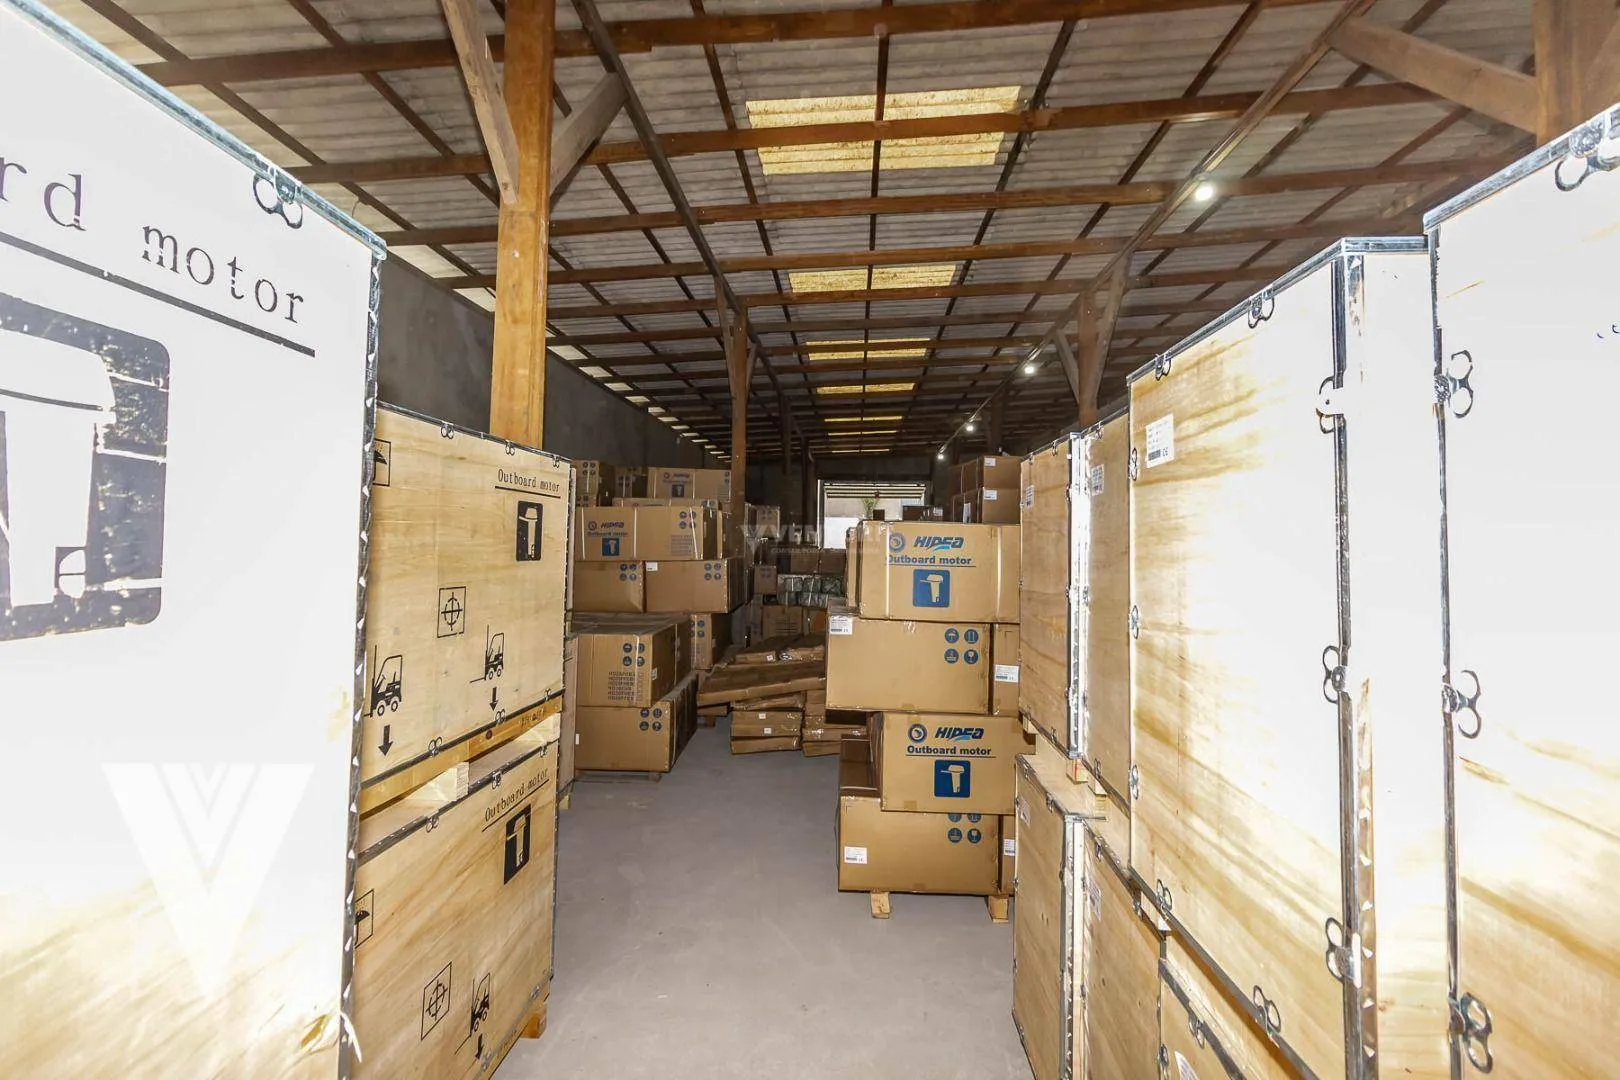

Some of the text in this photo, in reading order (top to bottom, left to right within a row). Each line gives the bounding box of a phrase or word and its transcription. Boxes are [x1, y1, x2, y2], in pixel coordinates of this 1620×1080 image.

[142, 225, 304, 323] motor
[497, 468, 560, 492] Outboard motor
[939, 556, 972, 566] motor
[907, 745, 992, 756] Outboard motor
[485, 768, 549, 822] Outboard motor
